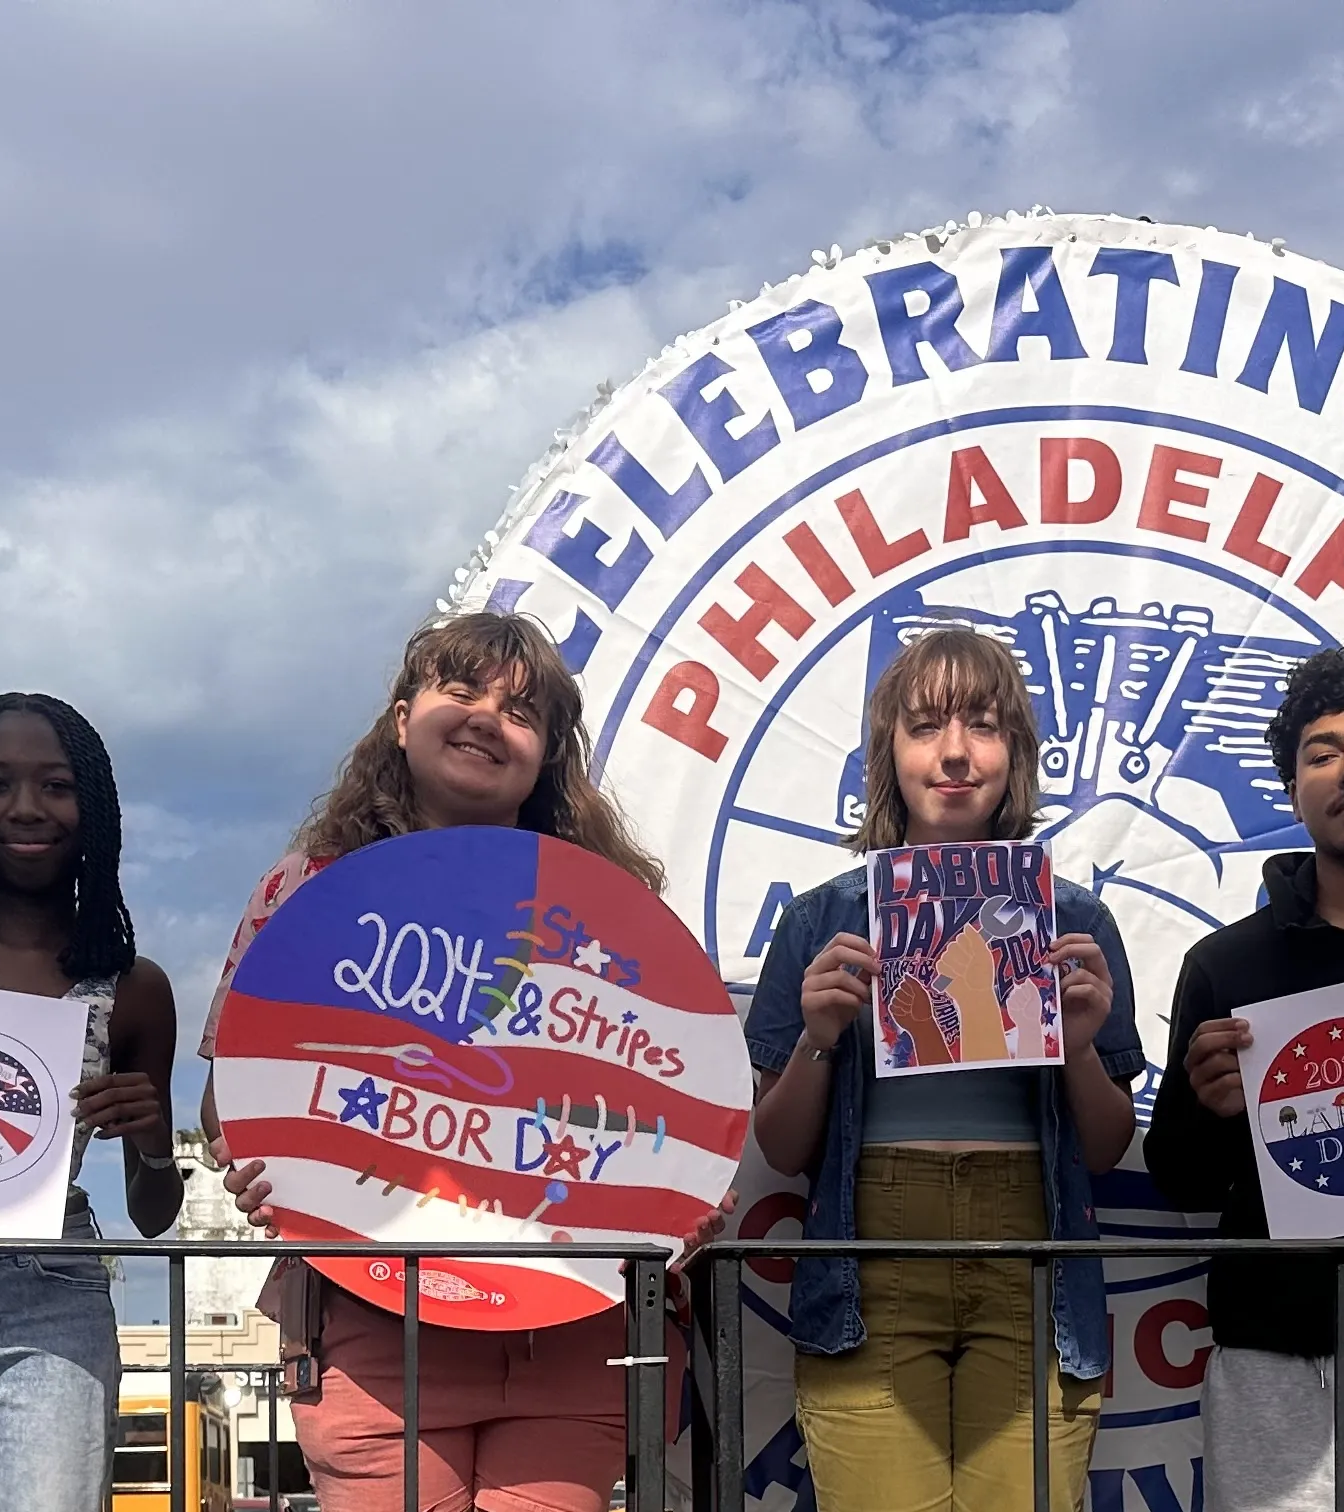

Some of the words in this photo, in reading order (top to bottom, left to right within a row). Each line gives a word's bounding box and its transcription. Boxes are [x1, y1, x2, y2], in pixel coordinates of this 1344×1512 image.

[876, 845, 1045, 906] LABOR
[334, 911, 493, 1025] 2024
[878, 898, 987, 961] DAY
[991, 906, 1052, 1002] 2024
[508, 983, 543, 1036] &
[547, 987, 686, 1078] Stripes
[490, 1292, 506, 1306] 19
